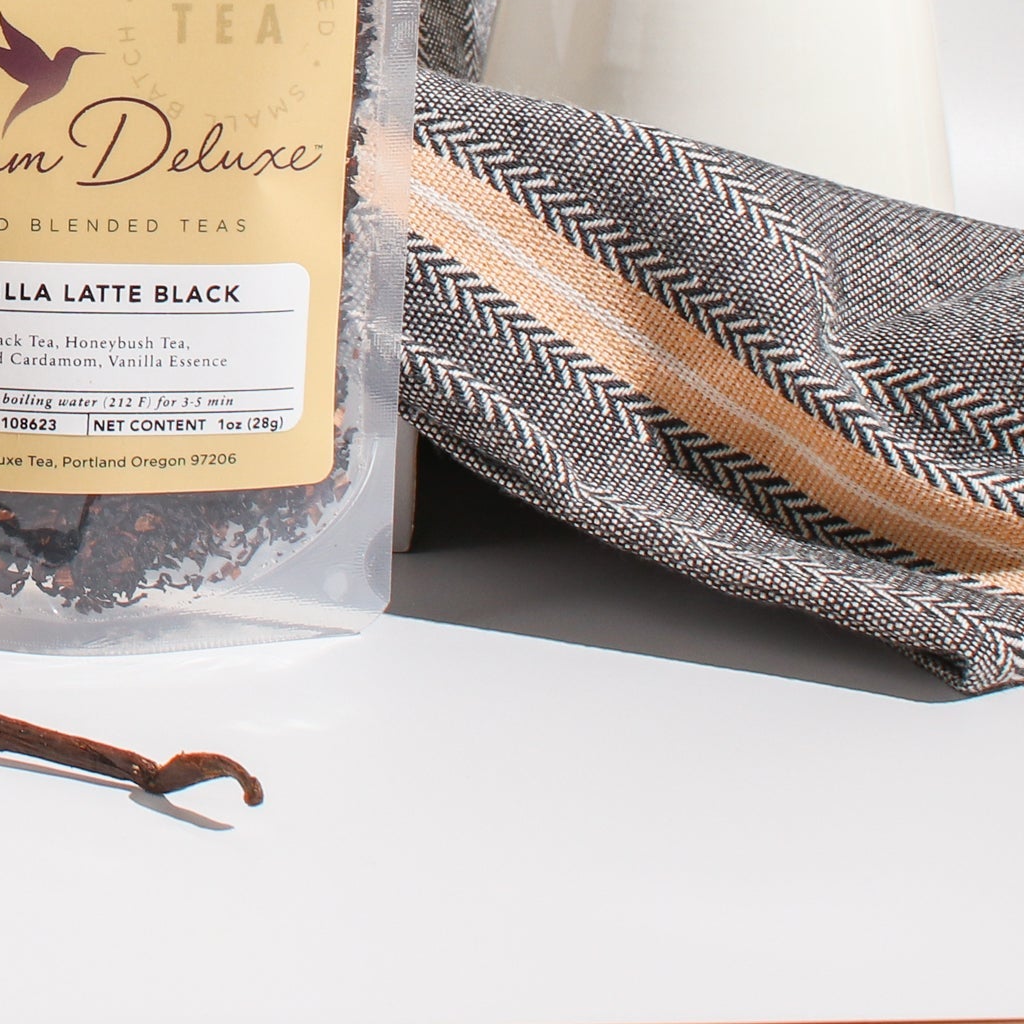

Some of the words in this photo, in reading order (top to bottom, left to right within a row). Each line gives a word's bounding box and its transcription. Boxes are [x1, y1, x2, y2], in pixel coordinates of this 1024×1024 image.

[171, 2, 283, 45] TEA
[29, 216, 160, 234] BLENDED
[179, 217, 248, 234] TEAS
[63, 283, 143, 304] LATTE
[153, 283, 241, 305] BLACK
[29, 334, 59, 350] Tea,
[64, 335, 155, 353] Honeybush
[161, 336, 191, 351] Tea,
[9, 351, 103, 369] Cardamom,
[108, 354, 164, 369] Vanilla
[168, 355, 229, 369] Essence
[2, 392, 54, 410] boiling
[58, 396, 98, 408] water
[102, 396, 133, 409] (212
[137, 396, 153, 409] F)
[154, 395, 177, 411] for
[181, 396, 203, 408] 3-5
[206, 394, 235, 407] min
[0, 416, 58, 432] 108623
[93, 418, 126, 433] NET
[129, 417, 208, 433] CONTENT
[216, 417, 244, 432] 1oz
[246, 415, 285, 434] (28g)
[26, 454, 59, 470] Tea,
[61, 454, 127, 470] Portland
[129, 453, 187, 470] Oregon
[189, 451, 238, 467] 97206
